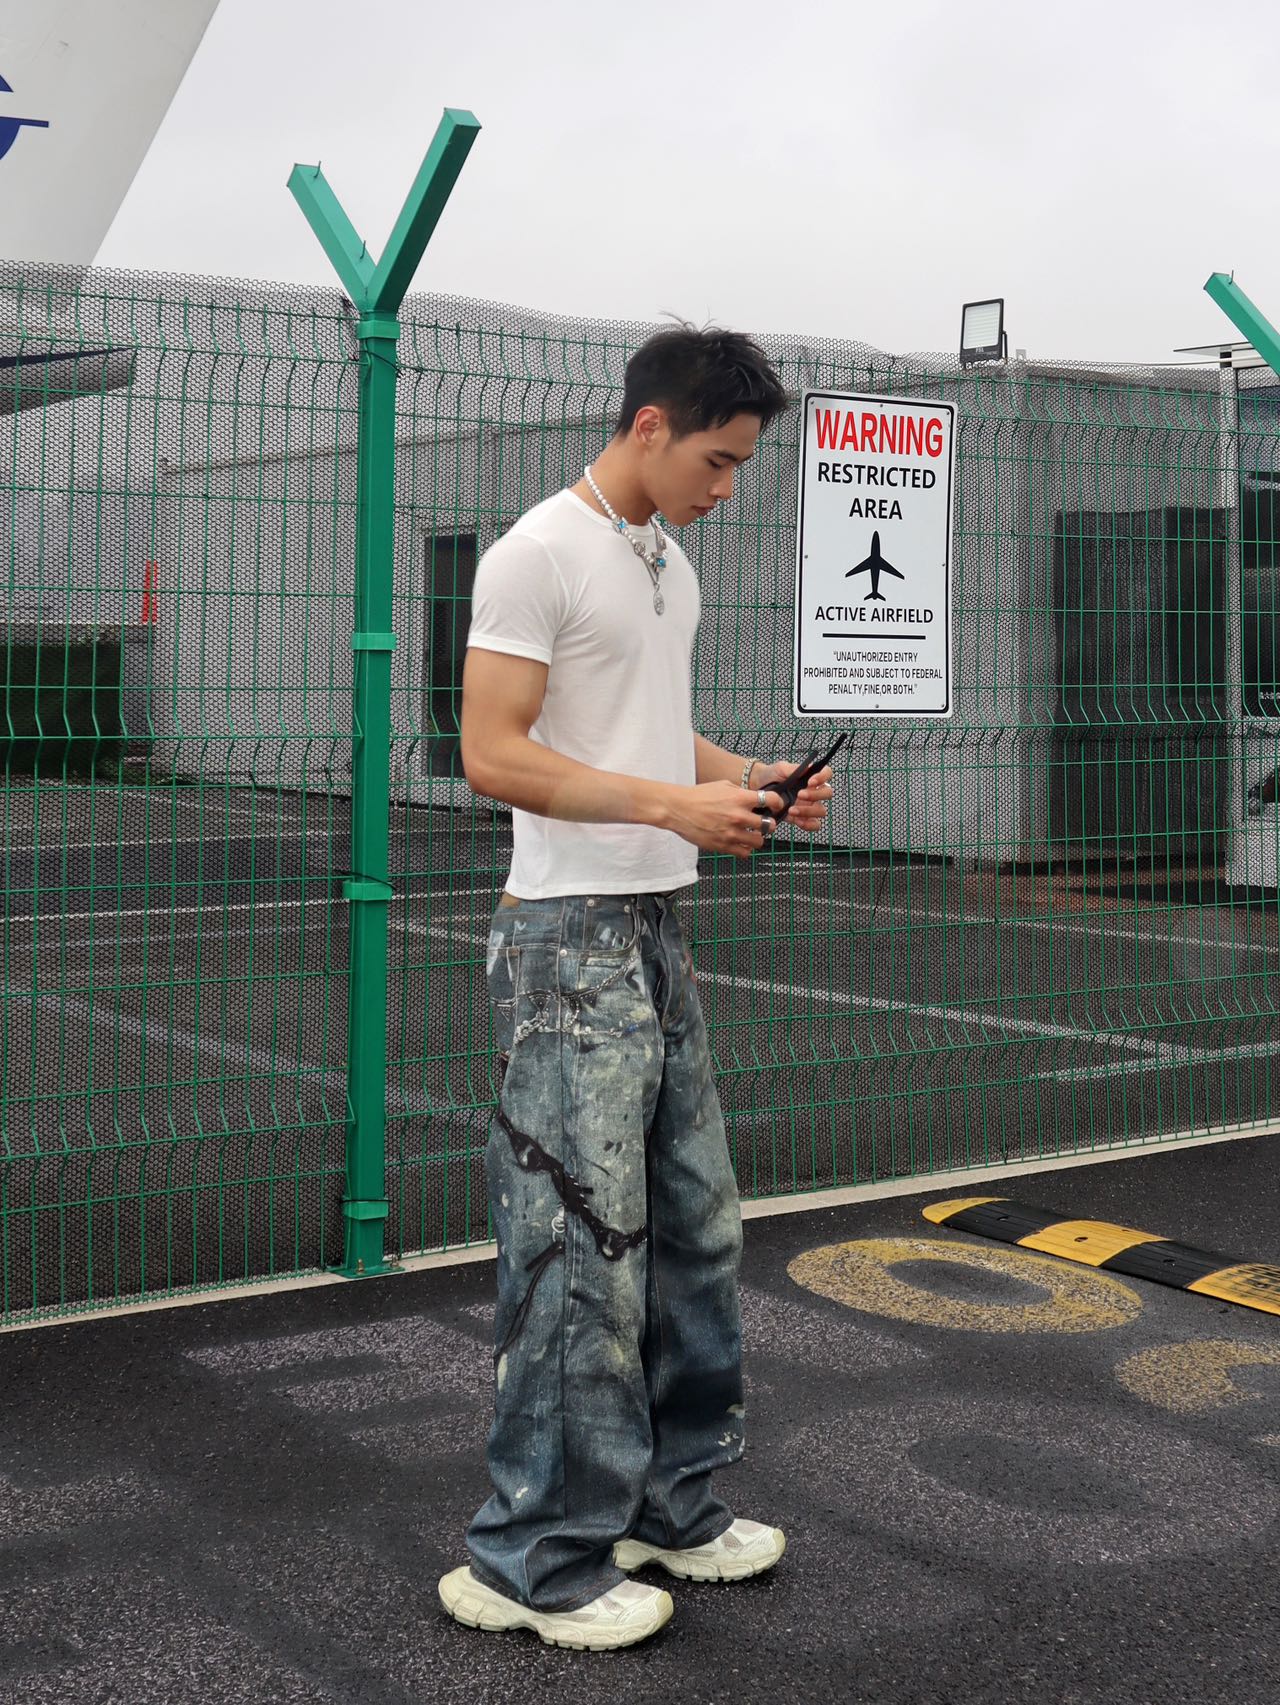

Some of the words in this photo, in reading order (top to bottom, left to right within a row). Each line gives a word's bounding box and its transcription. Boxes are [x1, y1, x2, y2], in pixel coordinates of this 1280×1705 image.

[815, 408, 943, 458] WARNING
[818, 462, 936, 489] RESTRICTED
[849, 498, 903, 520] AREA
[815, 606, 867, 622] ACTIVE
[871, 607, 934, 623] AIRFIELD
[894, 652, 918, 662] ENTRY
[803, 667, 848, 678] PROHIBITED
[849, 668, 865, 678] AND
[866, 668, 899, 678] SUBJECT
[901, 668, 911, 678] TO
[911, 668, 943, 679] FEDERAL
